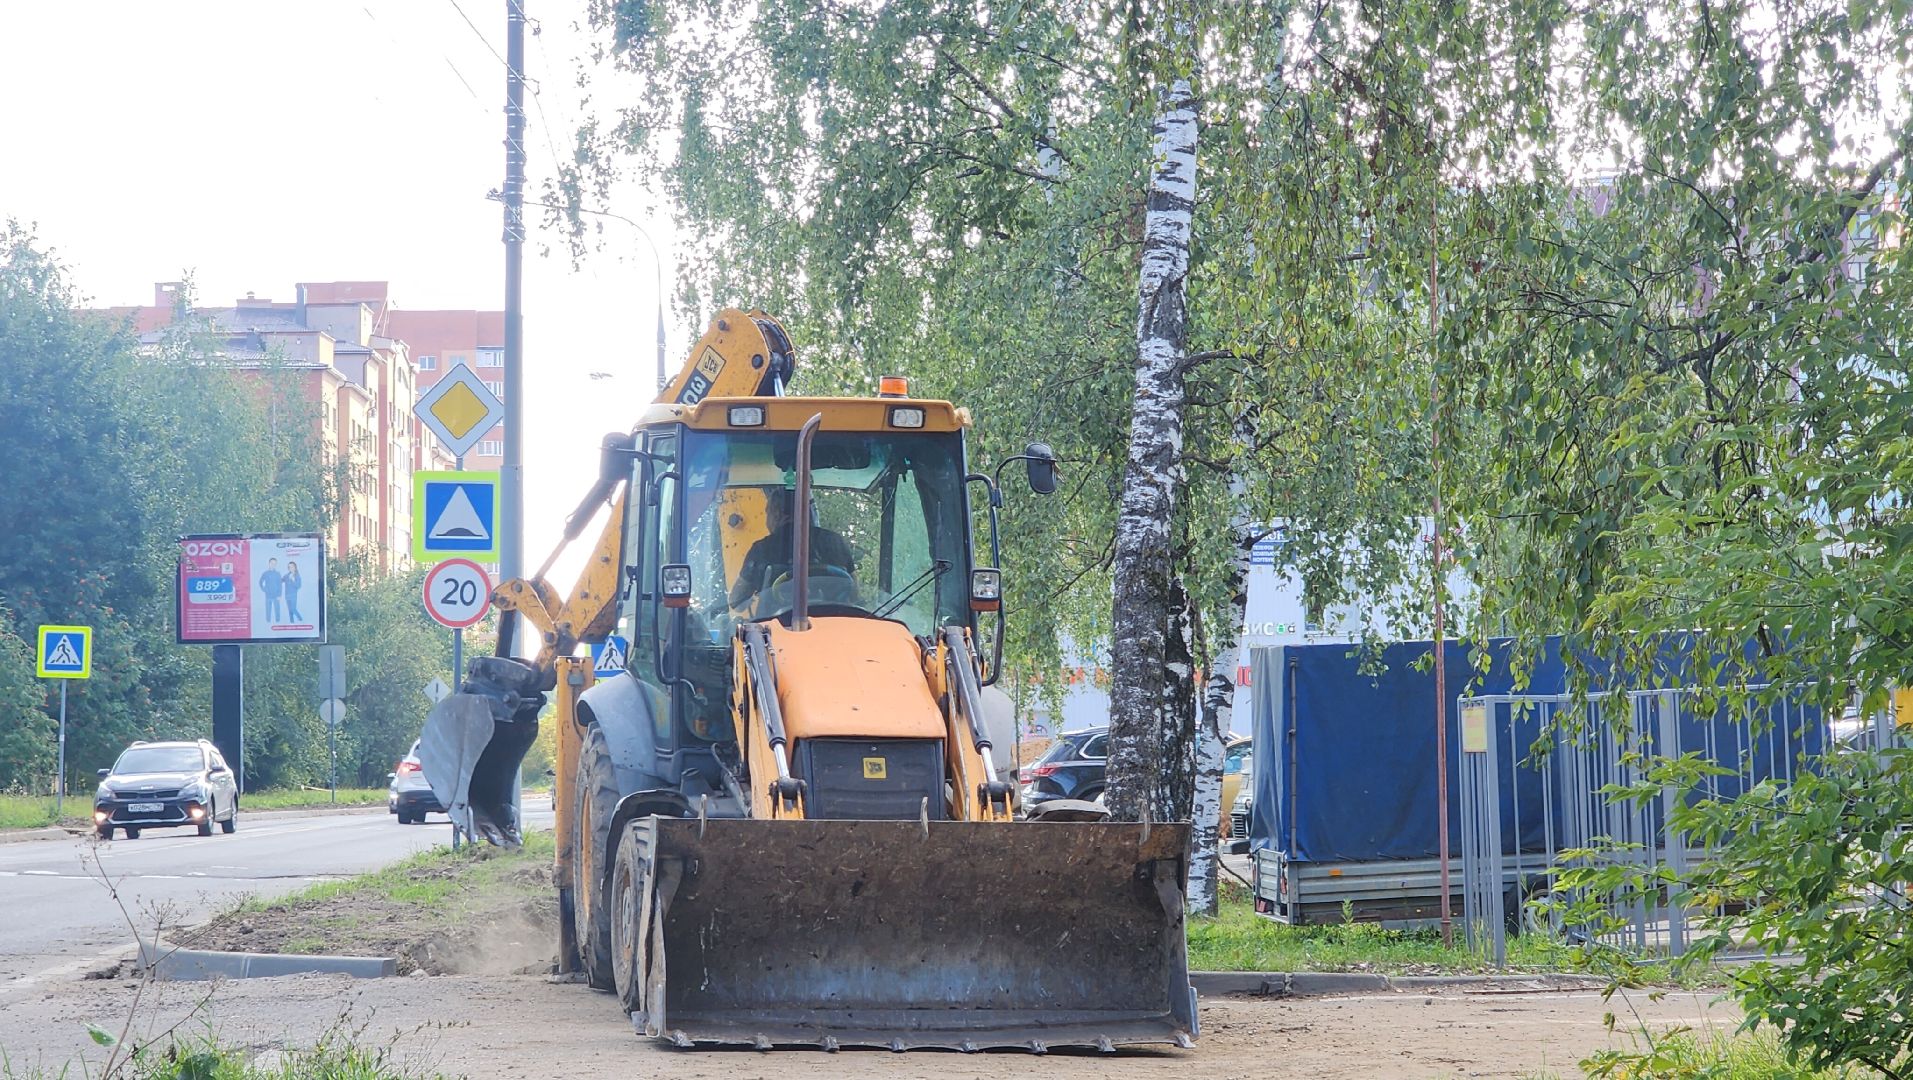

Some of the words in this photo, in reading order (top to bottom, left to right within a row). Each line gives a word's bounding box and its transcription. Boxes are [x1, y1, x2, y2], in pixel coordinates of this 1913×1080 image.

[680, 375, 707, 406] 3C
[185, 542, 243, 557] OZON
[195, 580, 220, 591] 889
[440, 578, 477, 607] 20
